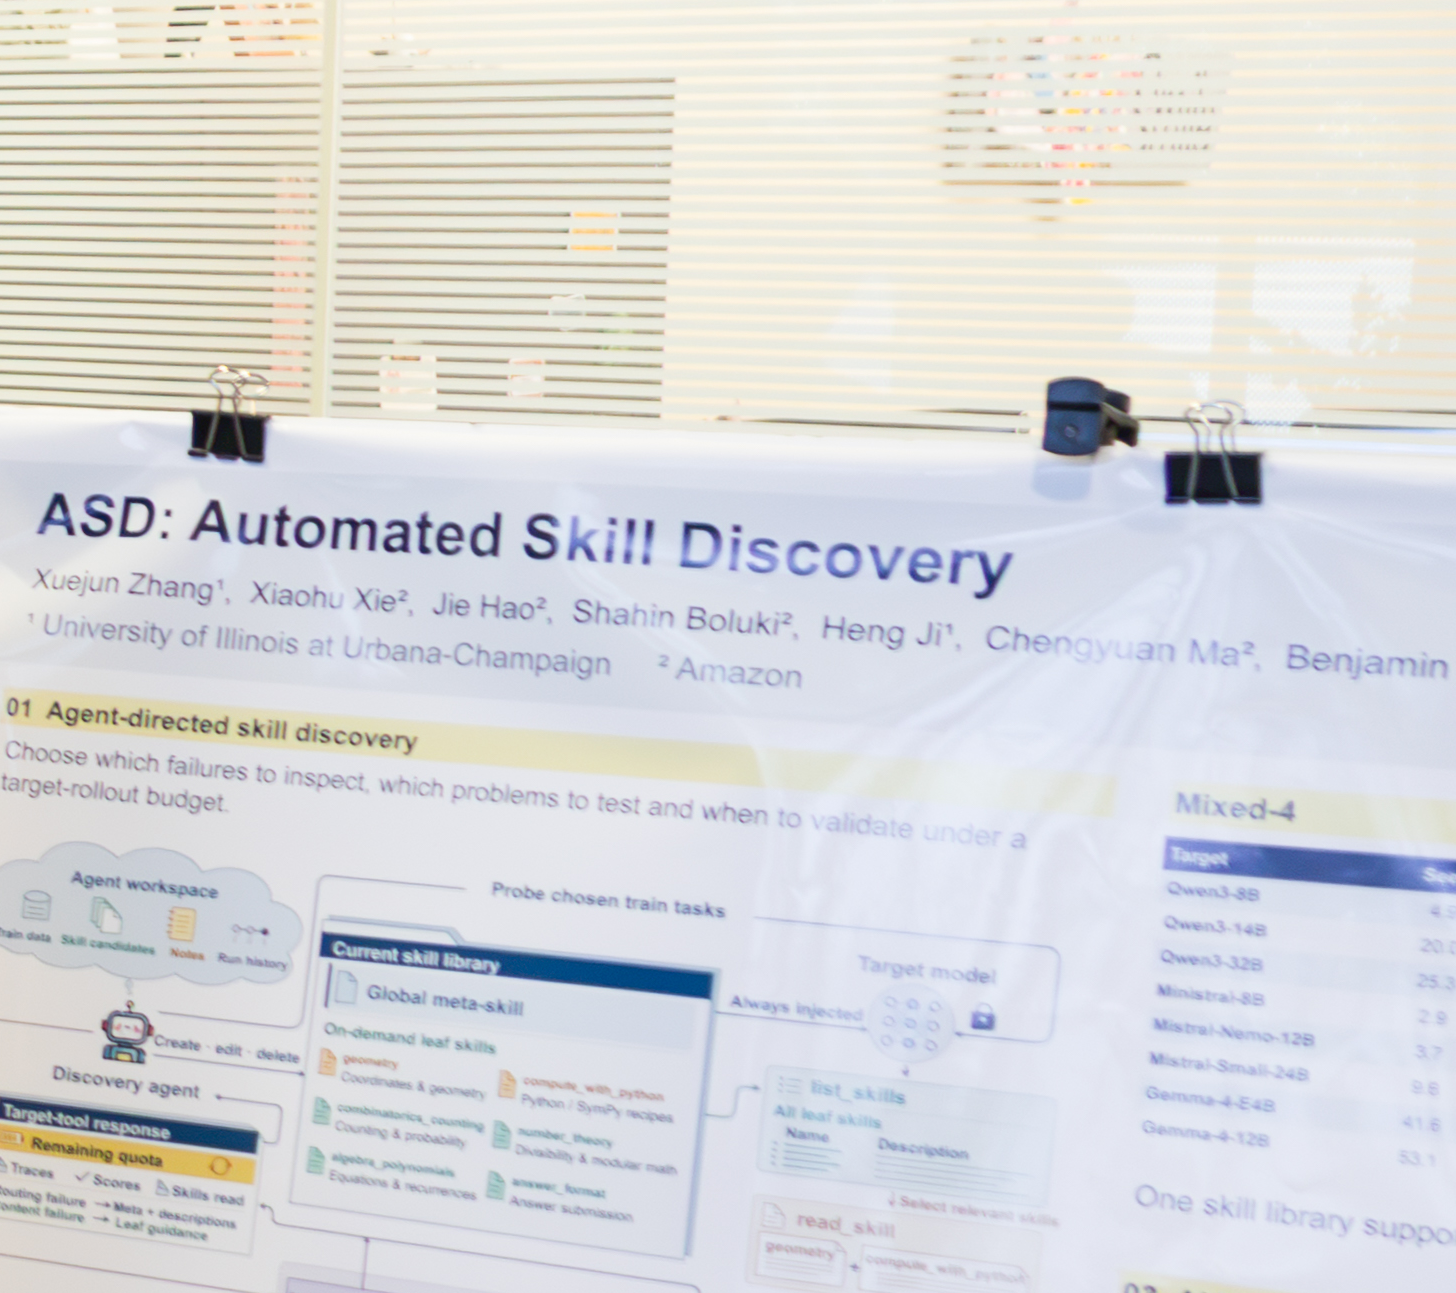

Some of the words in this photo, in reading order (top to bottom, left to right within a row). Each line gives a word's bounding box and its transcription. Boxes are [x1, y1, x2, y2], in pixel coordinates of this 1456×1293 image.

[35, 492, 173, 540] ASD:
[190, 500, 502, 559] Automated
[523, 513, 654, 566] Skill
[679, 519, 1013, 599] Discovery
[32, 567, 120, 599] Xuejun
[250, 580, 344, 611] Xiaohu
[432, 591, 471, 617] Jie
[572, 599, 673, 631] Shahin
[822, 615, 904, 651] Heng
[986, 625, 1176, 666] Chengyuan
[1287, 644, 1449, 683] Benjamin
[42, 613, 171, 651] University
[181, 623, 207, 649] of
[216, 627, 299, 657] Illinois
[309, 637, 333, 657] at
[344, 636, 610, 680] Urbana-Champaign
[676, 657, 802, 691] Amazon
[5, 694, 32, 719] 01
[46, 701, 228, 737] Agent-directed
[238, 714, 287, 742] skill
[295, 722, 418, 756] discovery
[1, 772, 139, 807] target-rollout
[145, 784, 229, 818] budget.
[4, 737, 88, 768] Choose
[96, 745, 159, 774] which
[167, 754, 247, 782] failures
[256, 763, 277, 785] to
[284, 766, 371, 797] inspect,
[379, 772, 443, 802] which
[451, 778, 559, 812] problems
[568, 789, 588, 811] to
[597, 792, 640, 816] test
[648, 794, 694, 821] and
[702, 802, 768, 829] when
[777, 808, 802, 829] to
[811, 810, 913, 841] validate
[923, 819, 1001, 849] under
[1009, 830, 1027, 851] a
[1175, 791, 1296, 822] Mixed-4
[71, 870, 122, 891] Agent
[127, 876, 219, 900] workspace
[491, 882, 546, 901] Probe
[551, 887, 619, 909] chosen
[625, 895, 668, 913] train
[674, 898, 726, 920] tasks
[366, 984, 427, 1006] Global
[433, 992, 524, 1017] meta-skill
[52, 1064, 145, 1094] Discovery
[148, 1079, 200, 1099] agent
[1135, 1184, 1193, 1213] One
[1202, 1191, 1256, 1222] skill
[1267, 1200, 1354, 1238] library
[1363, 1218, 1456, 1249] suppo
